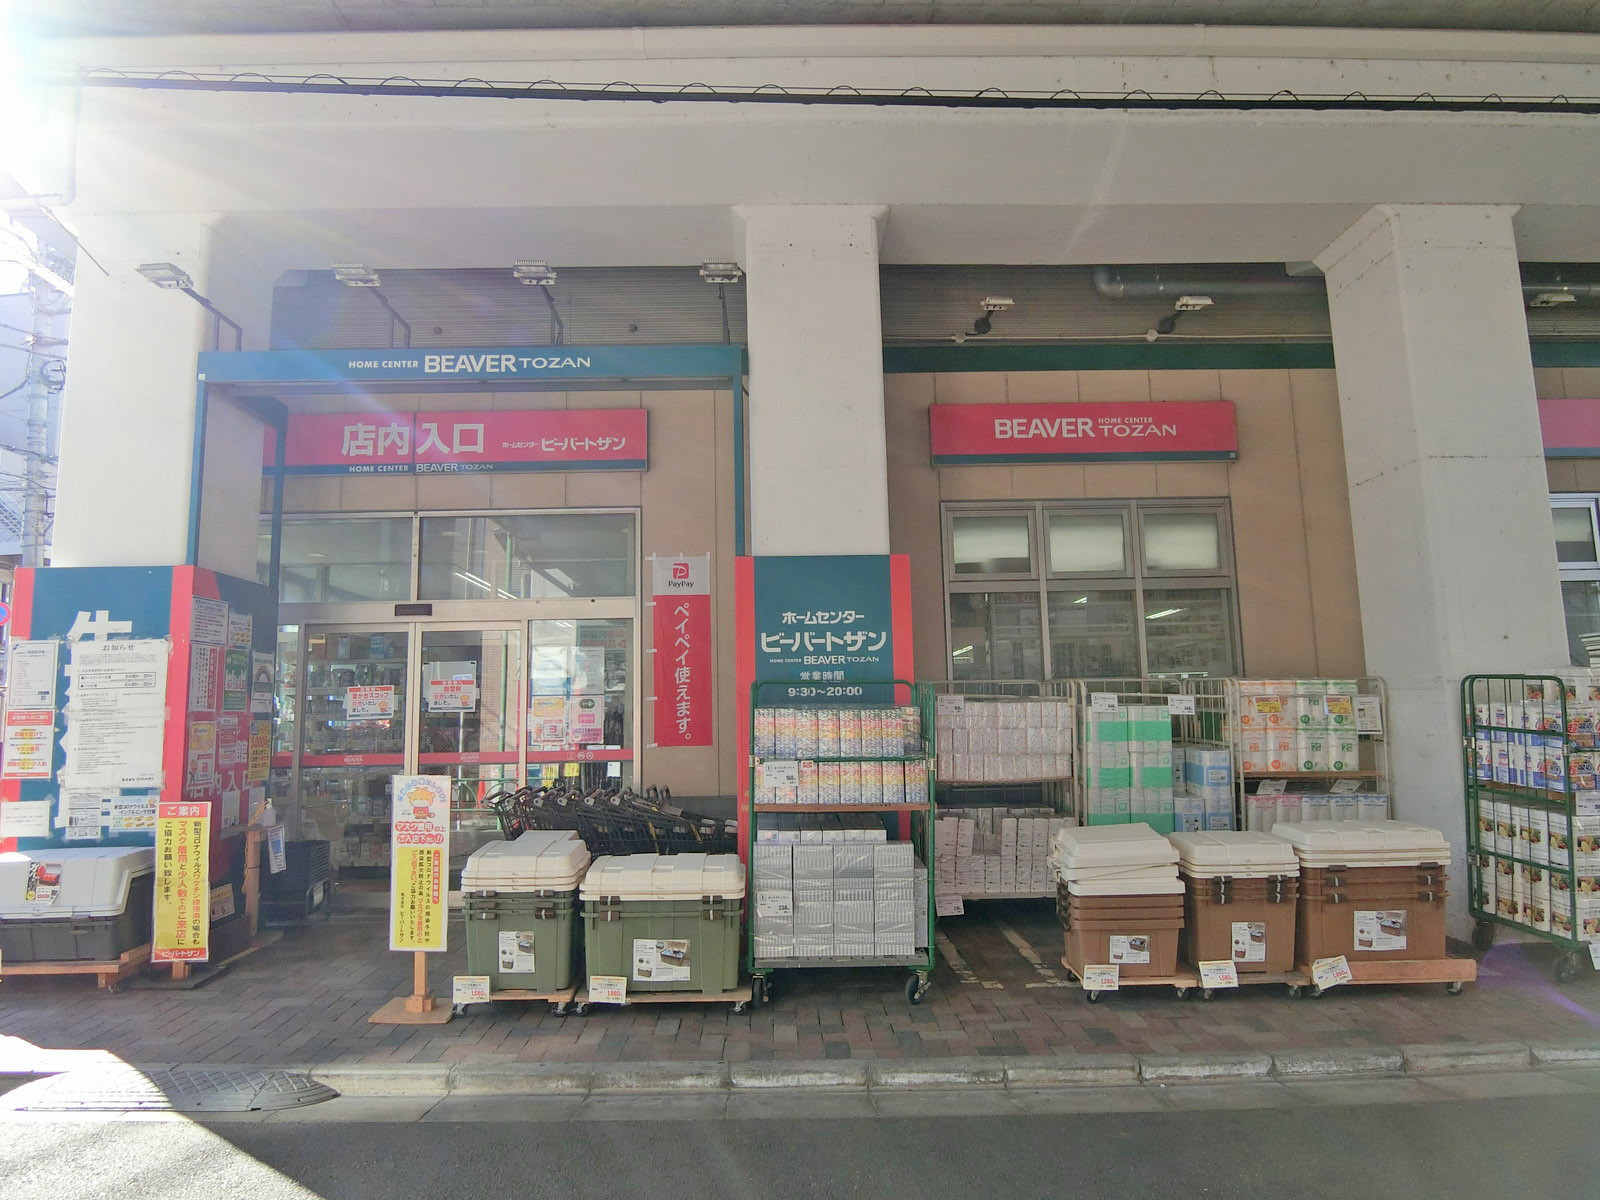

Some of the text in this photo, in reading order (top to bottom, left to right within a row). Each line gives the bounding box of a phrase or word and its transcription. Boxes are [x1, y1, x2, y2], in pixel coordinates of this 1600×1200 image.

[348, 354, 591, 373] HOME CENTER BEAVER TOZAN
[994, 418, 1177, 439] BEAVER TOZAN
[341, 422, 485, 457] 店内入口
[541, 437, 626, 452] ビーバートザン
[349, 463, 494, 473] HOME CENTER BEAVER TOZAN
[668, 580, 694, 588] PayPay
[782, 610, 864, 624] ホームセンター
[102, 643, 135, 652] お知らせ
[761, 631, 886, 652] ビーバートザン
[803, 655, 846, 665] BEAVER
[674, 602, 692, 740] ペイペイ使えます。
[167, 806, 200, 816] ご案内
